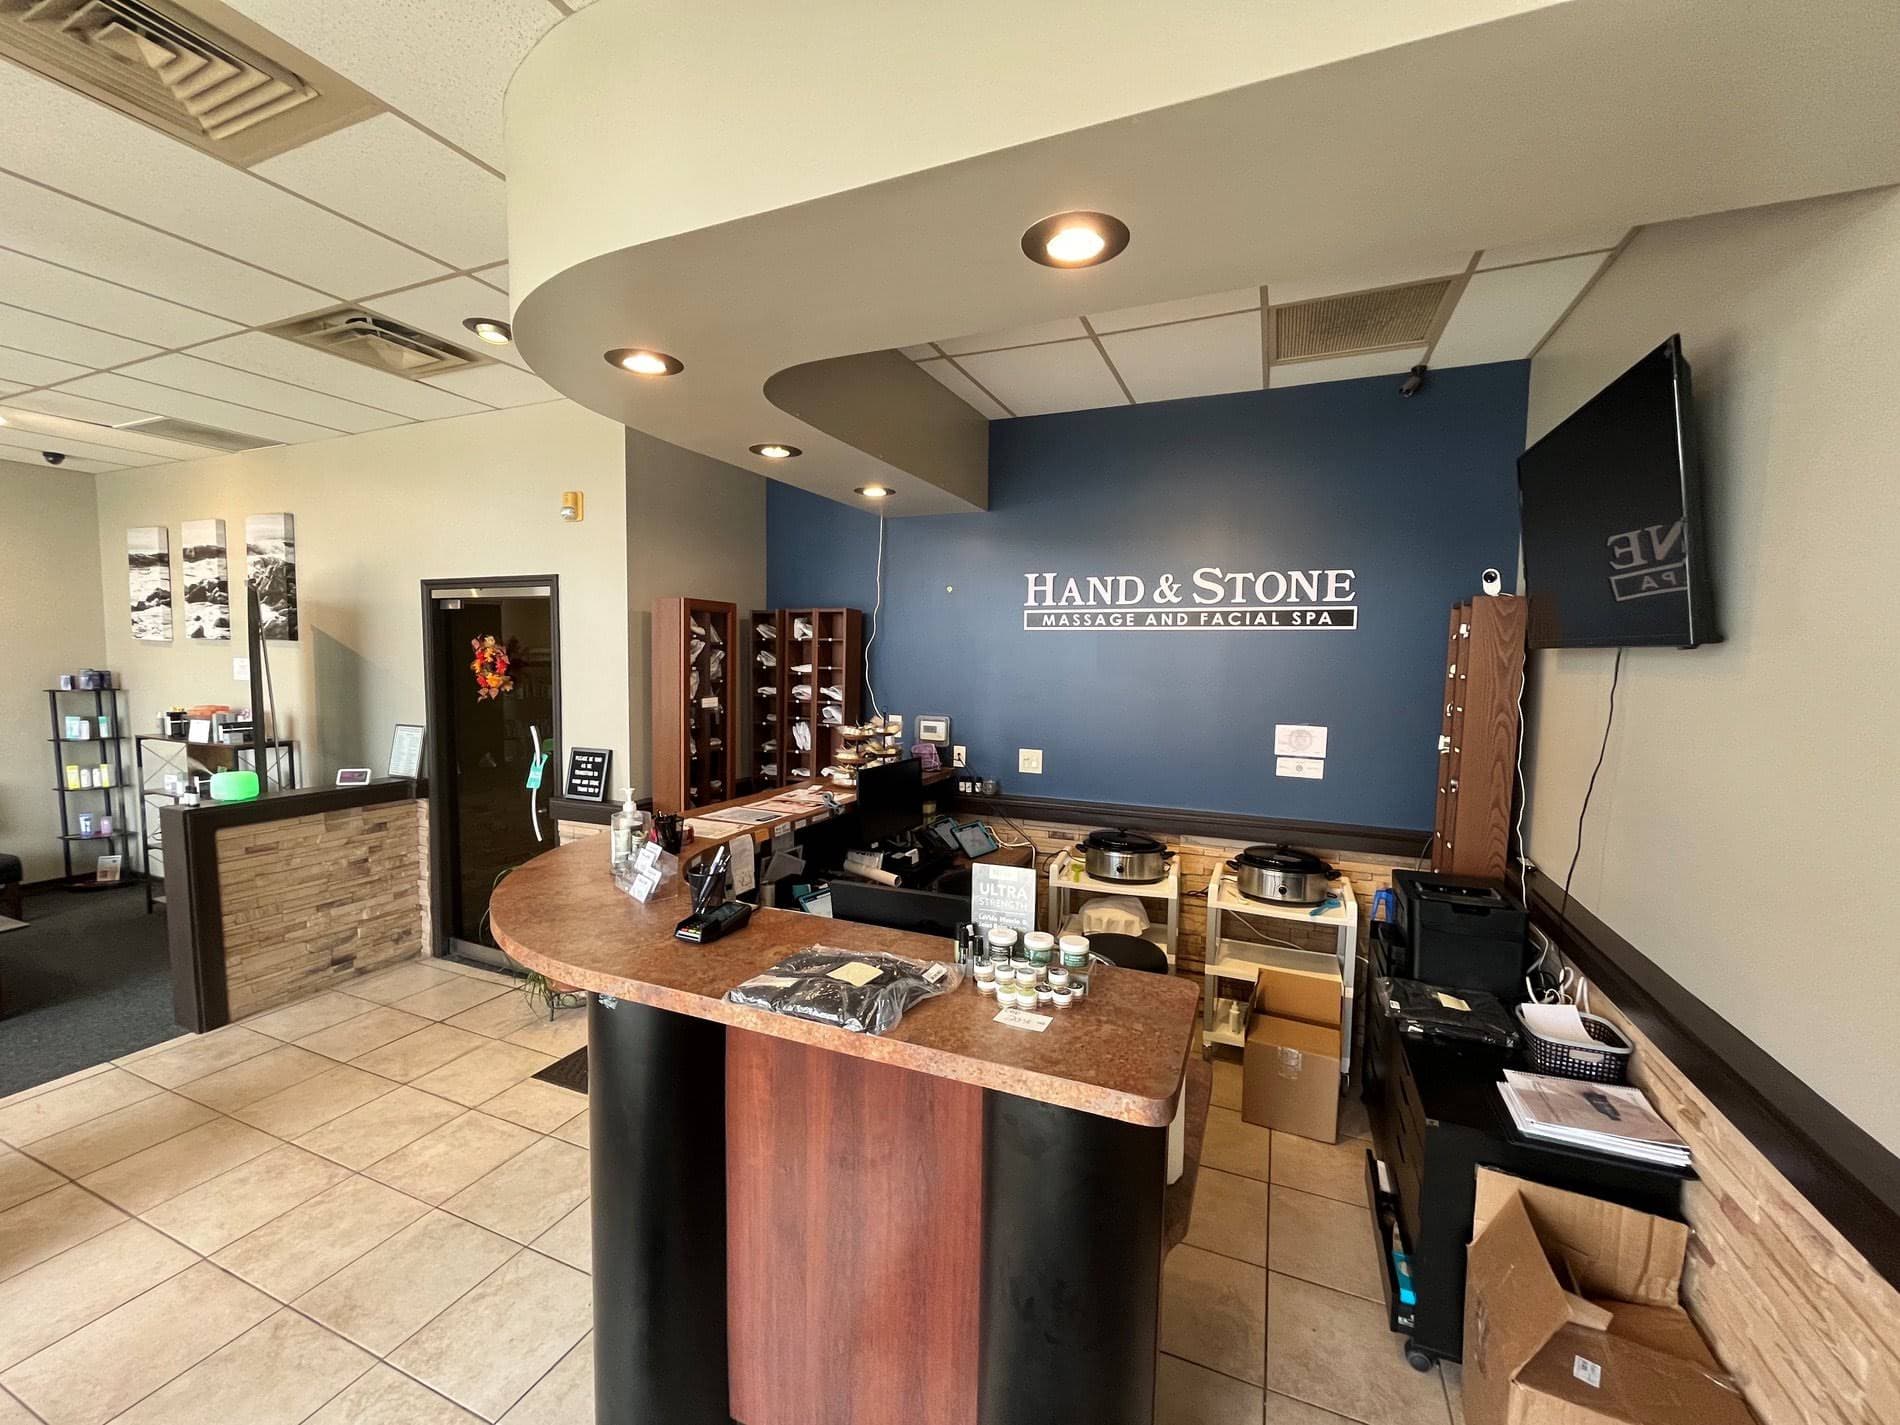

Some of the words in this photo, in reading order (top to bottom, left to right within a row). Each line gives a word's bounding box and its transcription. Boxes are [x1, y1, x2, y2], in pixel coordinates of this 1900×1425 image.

[1023, 572, 1145, 606] HAND
[1153, 573, 1183, 604] &
[1191, 567, 1356, 604] STONE
[1042, 612, 1135, 627] MASSAGE
[1145, 612, 1189, 627] AND
[1200, 612, 1280, 626] FACIAL
[1291, 611, 1333, 626] SPA
[979, 882, 1028, 900] ULTRA
